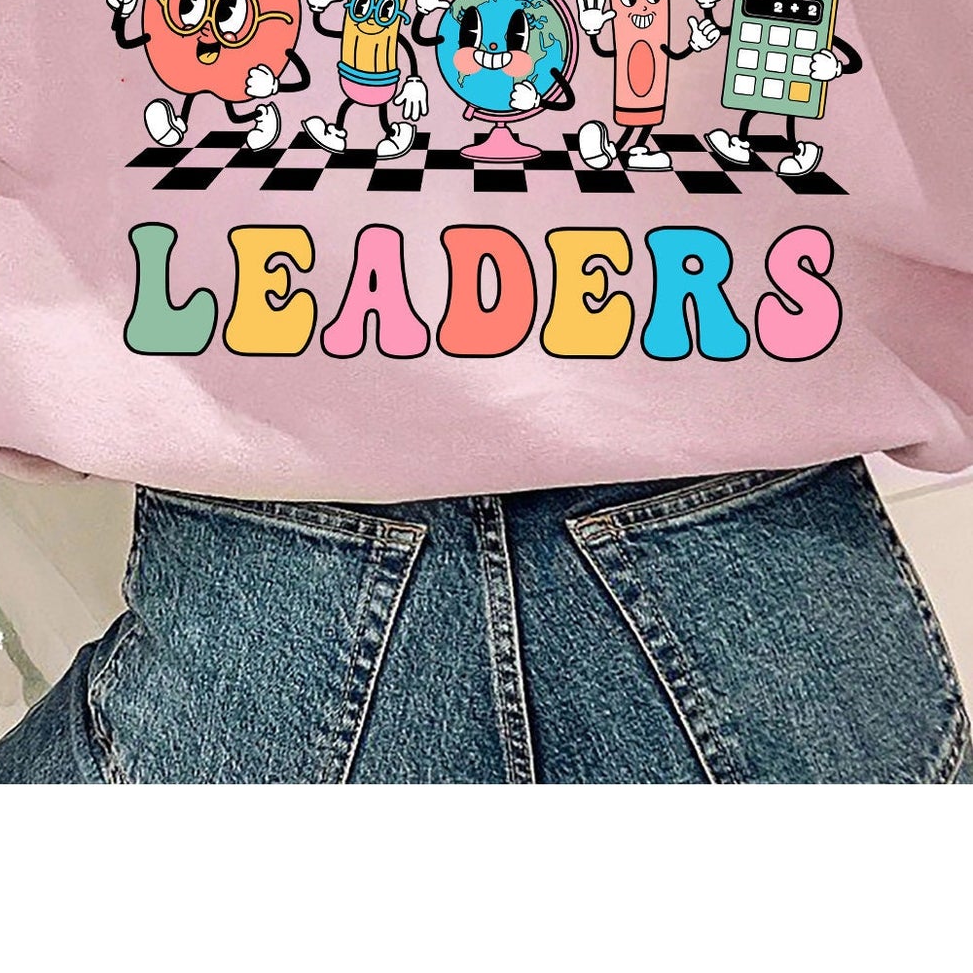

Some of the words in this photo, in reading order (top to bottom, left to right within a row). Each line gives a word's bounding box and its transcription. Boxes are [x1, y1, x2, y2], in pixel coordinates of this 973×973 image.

[773, 2, 783, 13] 2
[807, 4, 818, 16] 2
[123, 222, 843, 362] LEADERS
